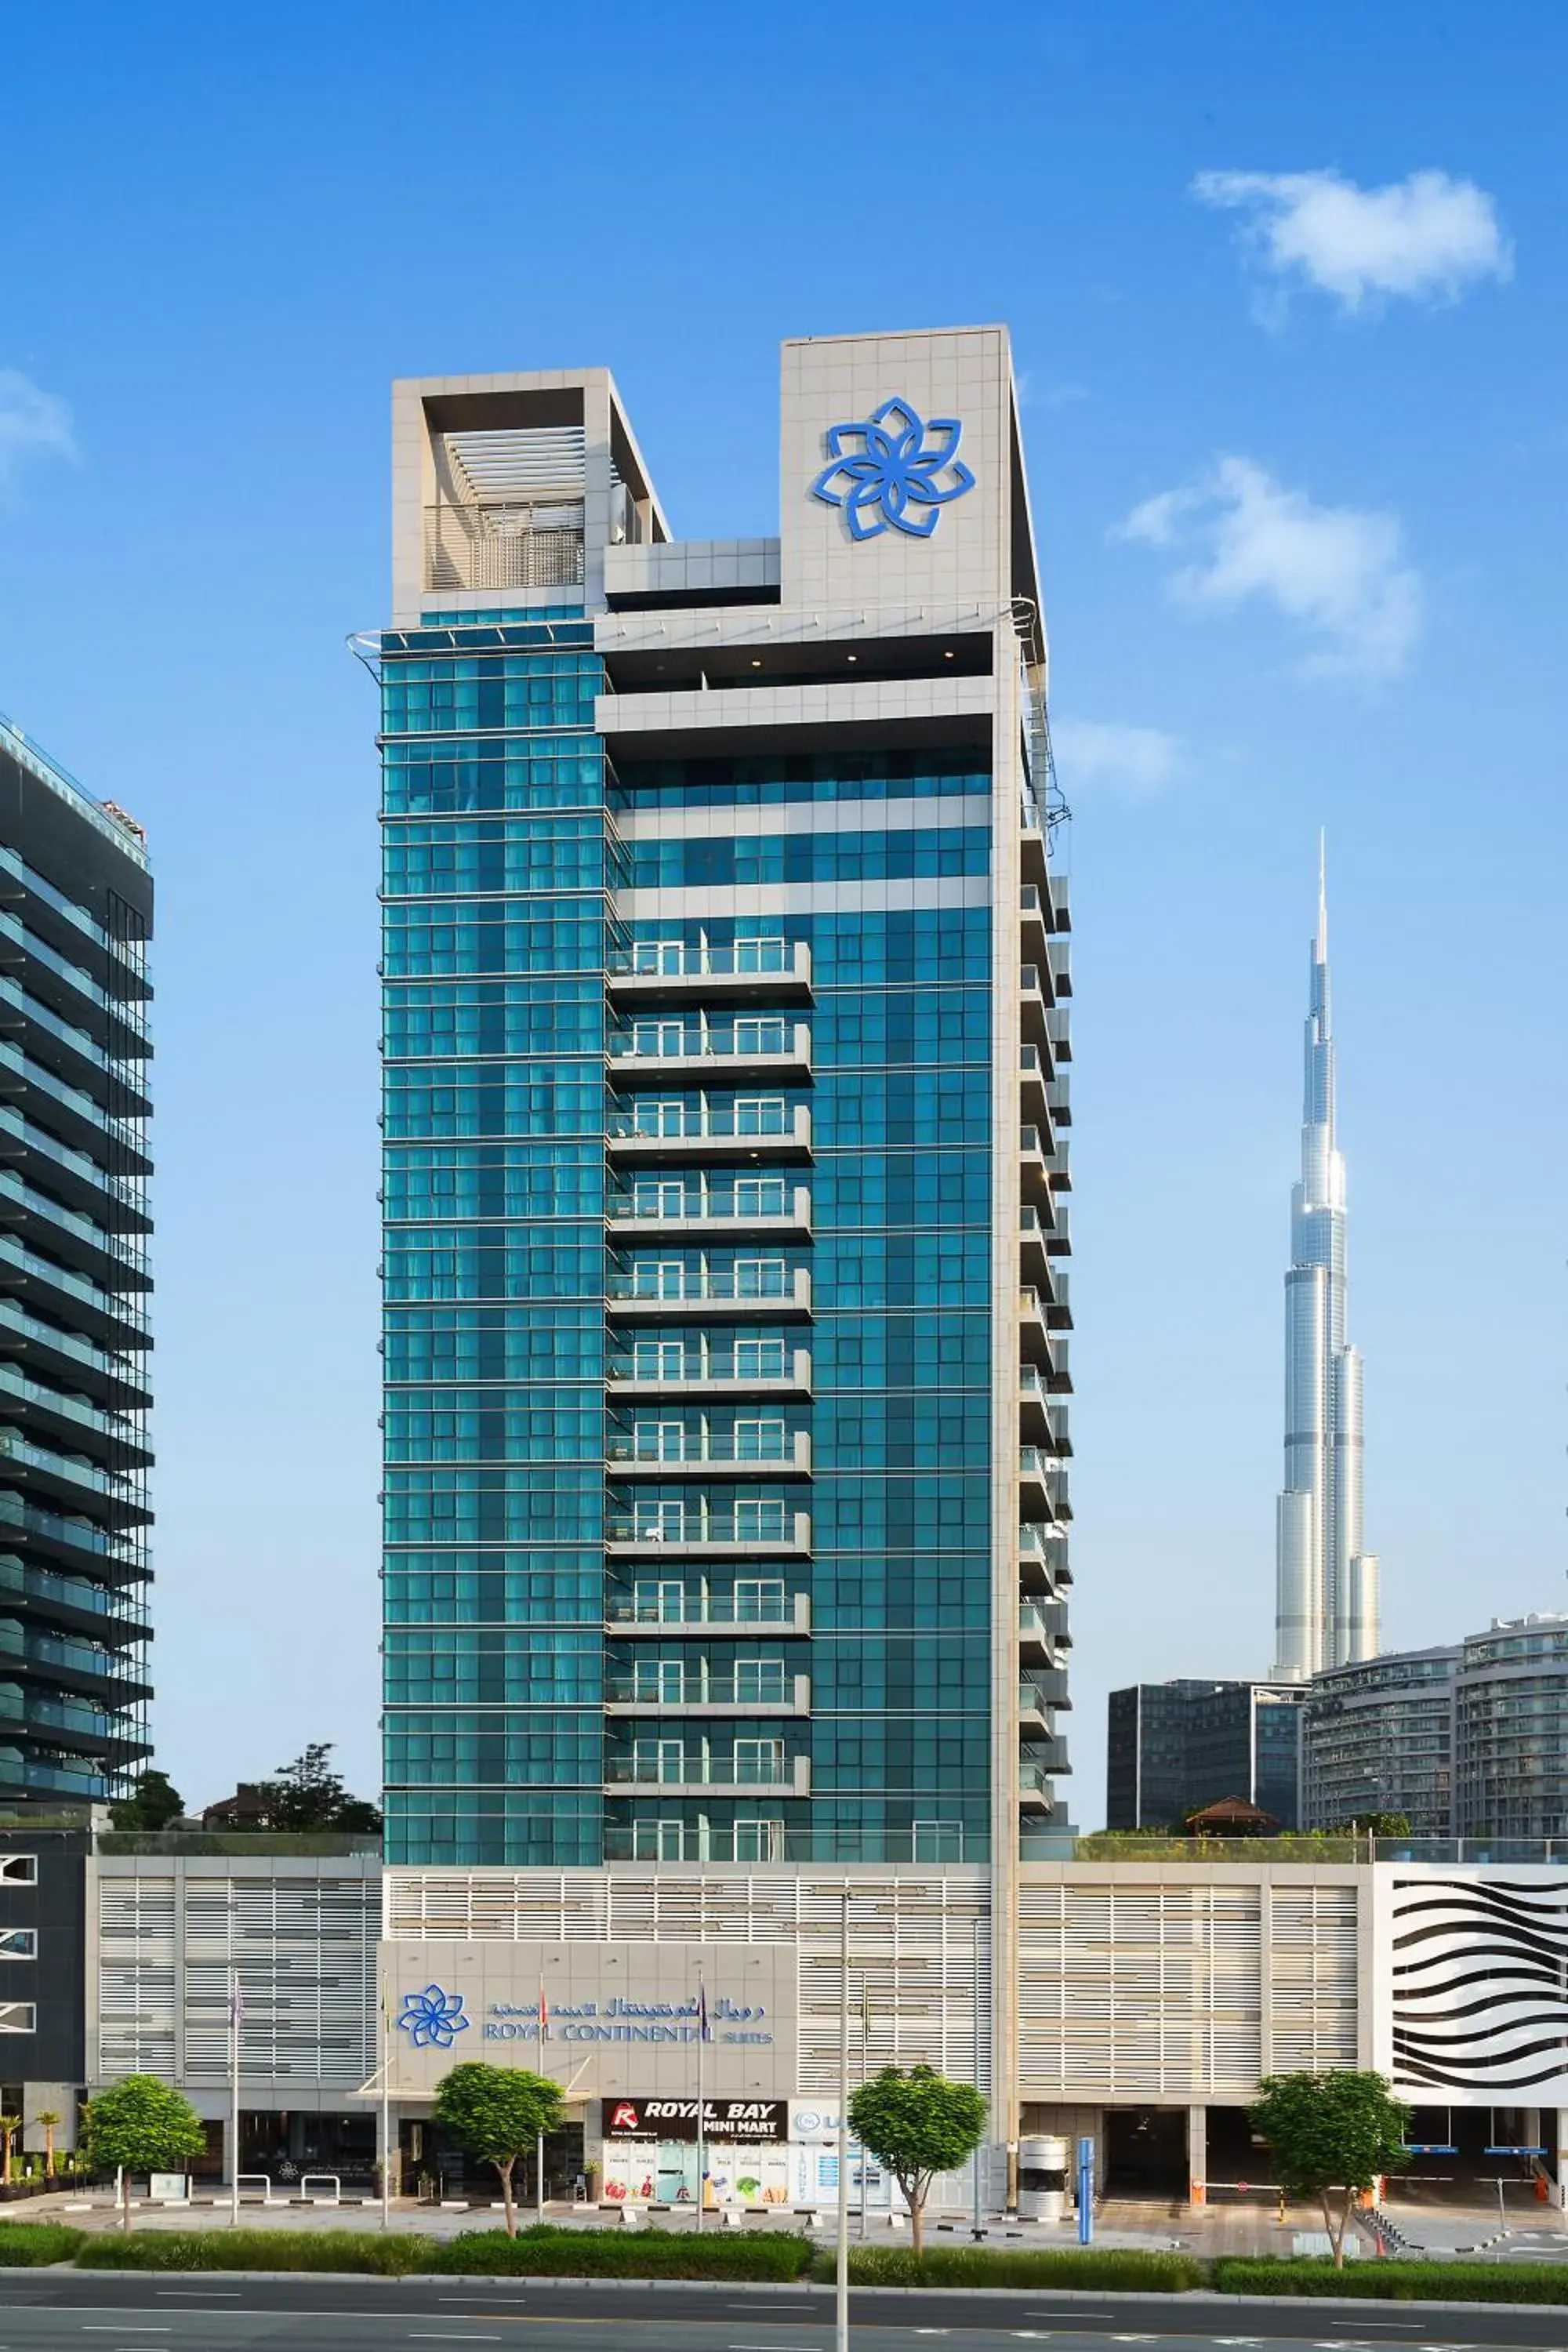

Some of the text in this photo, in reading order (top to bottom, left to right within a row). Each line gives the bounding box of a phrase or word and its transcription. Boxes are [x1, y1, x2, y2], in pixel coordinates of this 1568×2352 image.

[485, 2023, 554, 2041] ROYAL
[644, 2101, 776, 2119] ROYAL BAY
[703, 2121, 778, 2133] MINI MART
